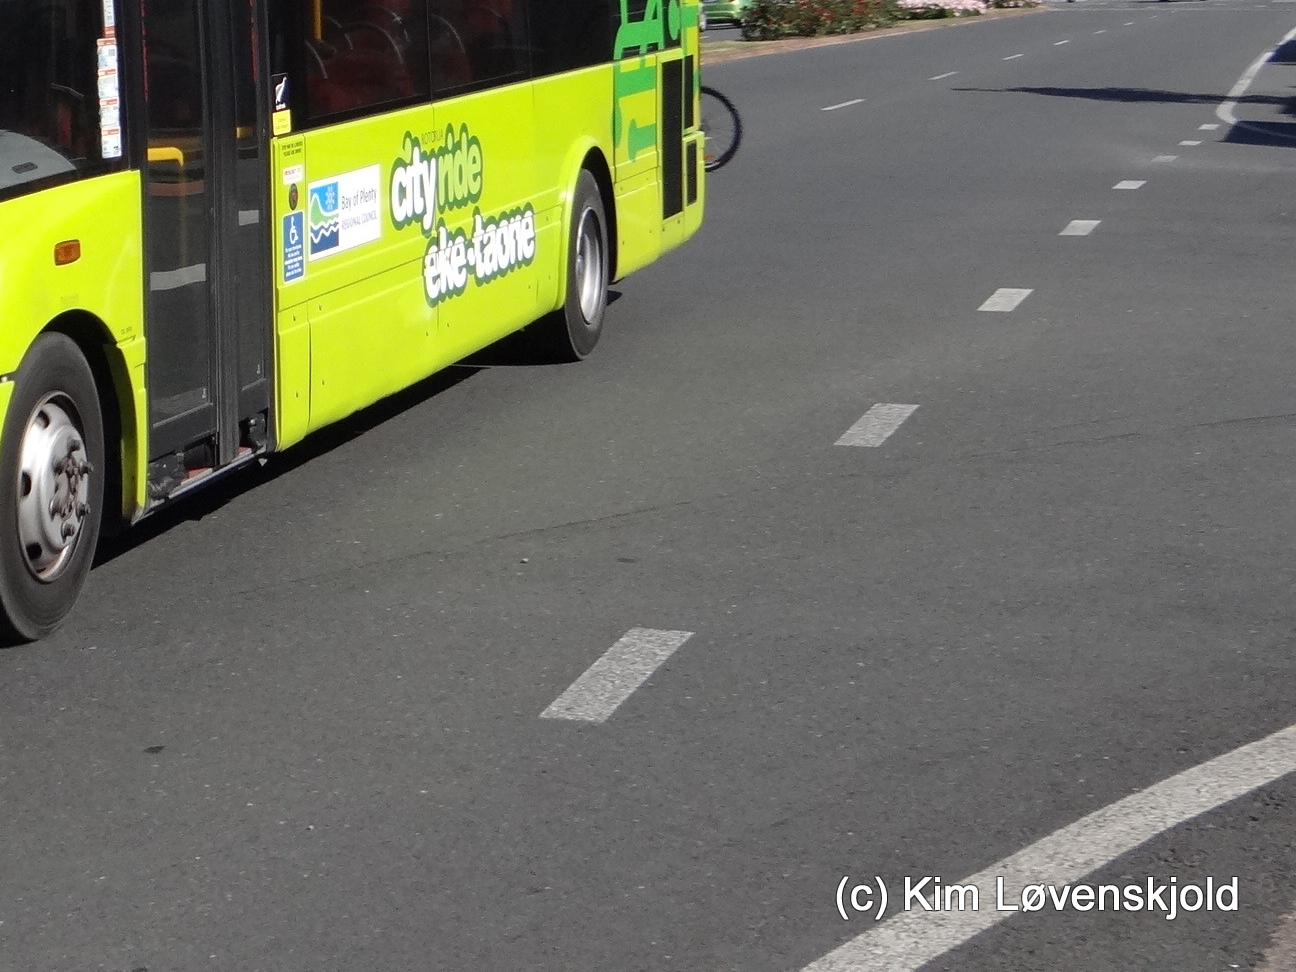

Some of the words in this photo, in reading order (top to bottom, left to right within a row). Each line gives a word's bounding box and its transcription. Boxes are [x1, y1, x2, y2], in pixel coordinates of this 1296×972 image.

[341, 194, 352, 212] Bay
[353, 192, 359, 207] of
[360, 187, 377, 206] Plenty
